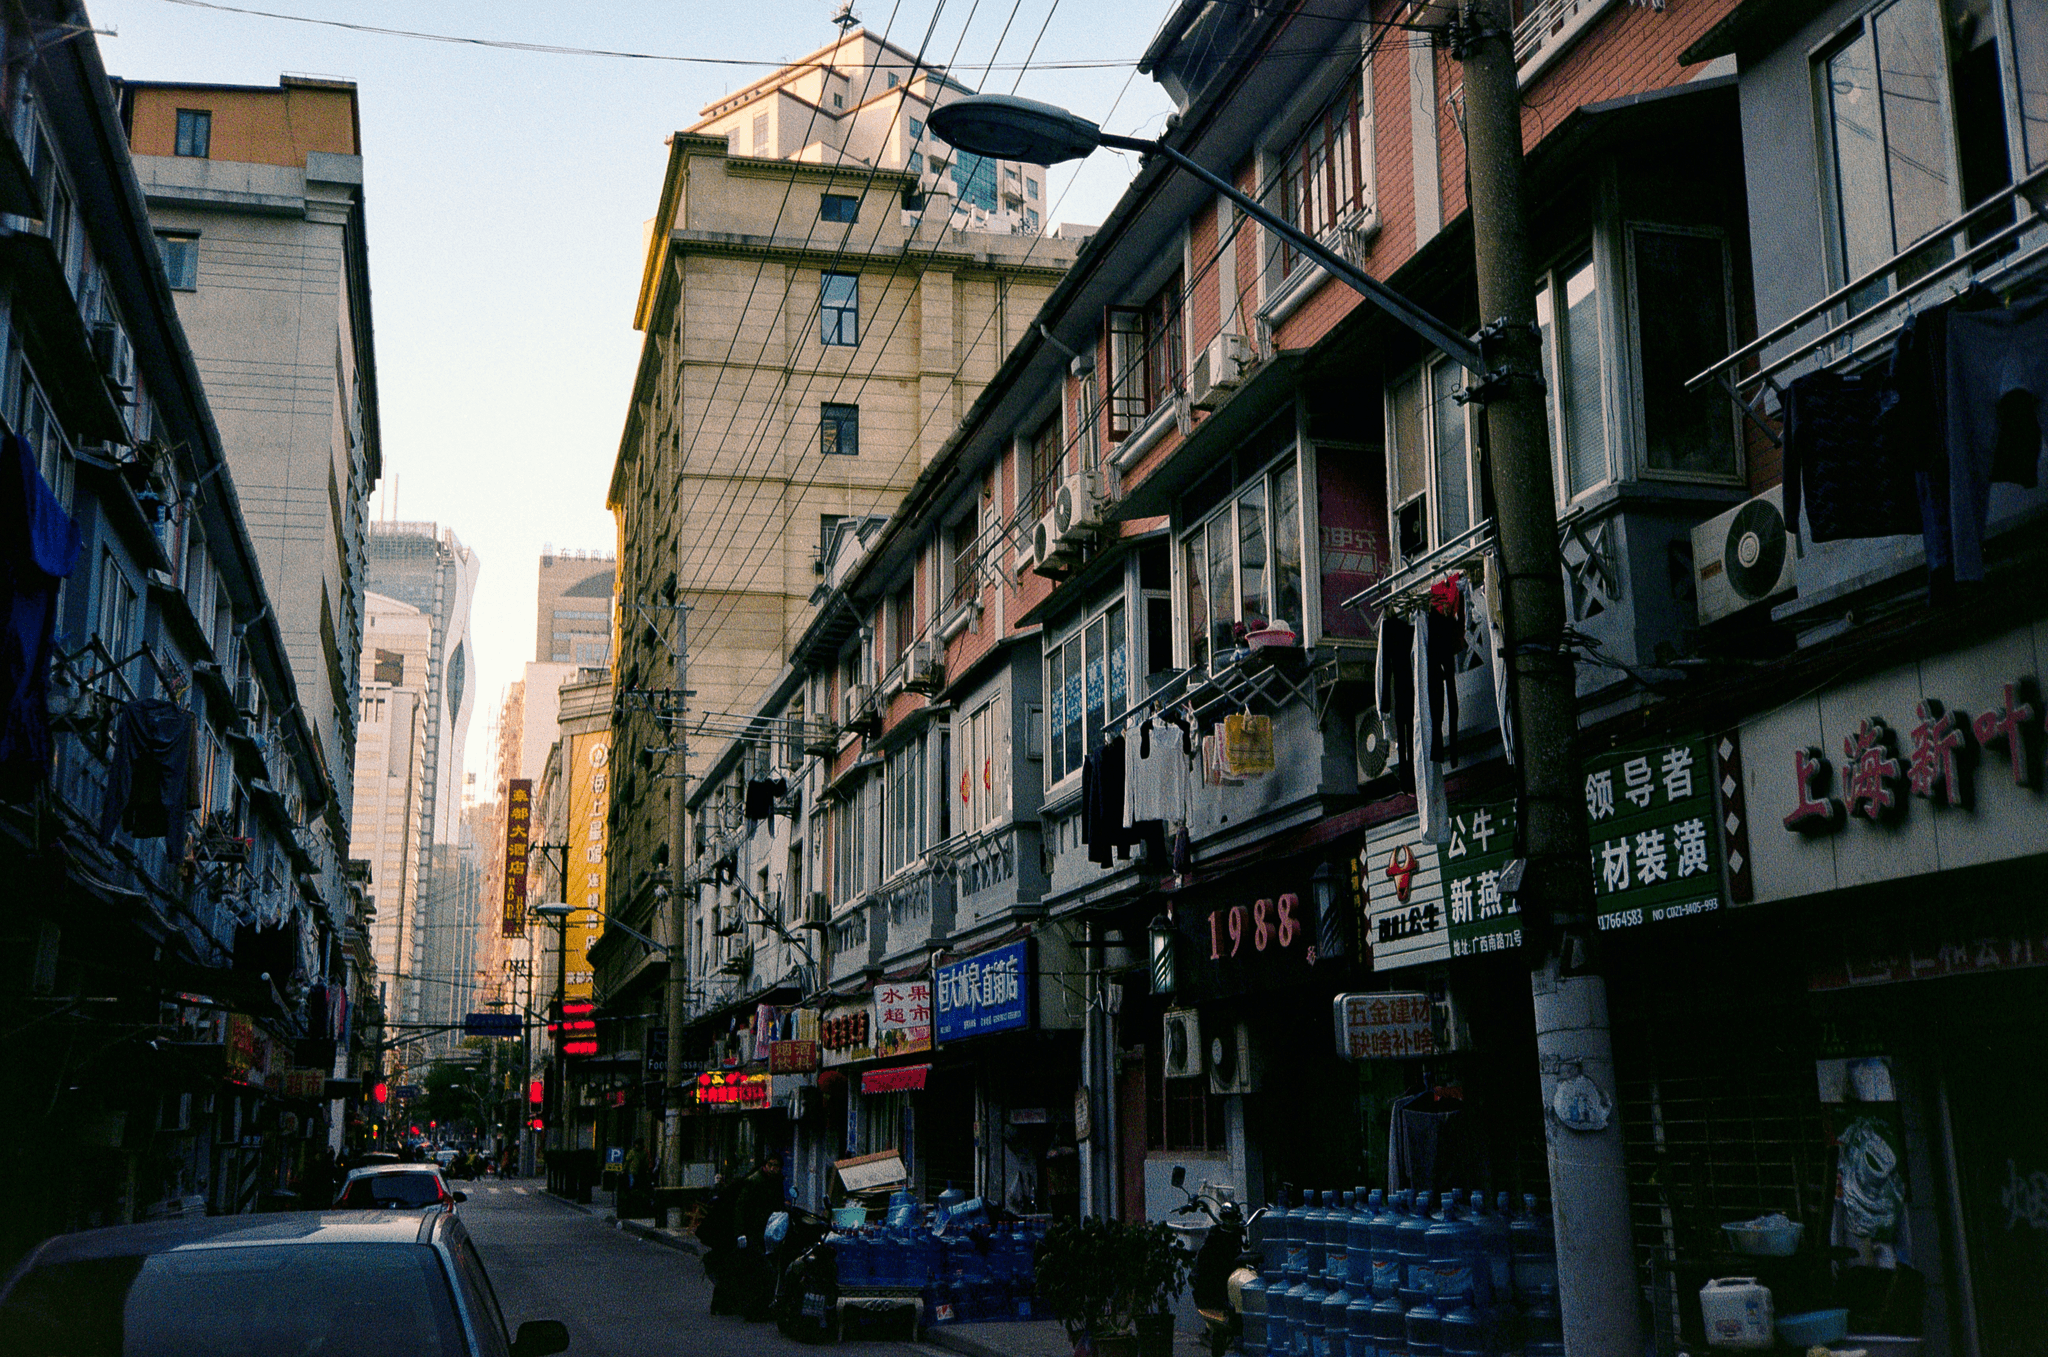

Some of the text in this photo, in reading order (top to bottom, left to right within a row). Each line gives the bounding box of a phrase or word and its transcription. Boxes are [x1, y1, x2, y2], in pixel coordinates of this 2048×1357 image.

[1783, 684, 2033, 831] 上海新叶
[1448, 747, 1693, 859] 公牛· 领导者
[1450, 818, 1708, 924] 新燕 材装潢
[1207, 893, 1298, 960] 1988
[881, 985, 930, 1004] 水果
[883, 1004, 930, 1023] 超市
[1348, 997, 1430, 1026] 五金建材
[776, 1042, 811, 1056] 烟酒
[1350, 1028, 1433, 1057] 缺啥补啥
[611, 1149, 621, 1162] P
